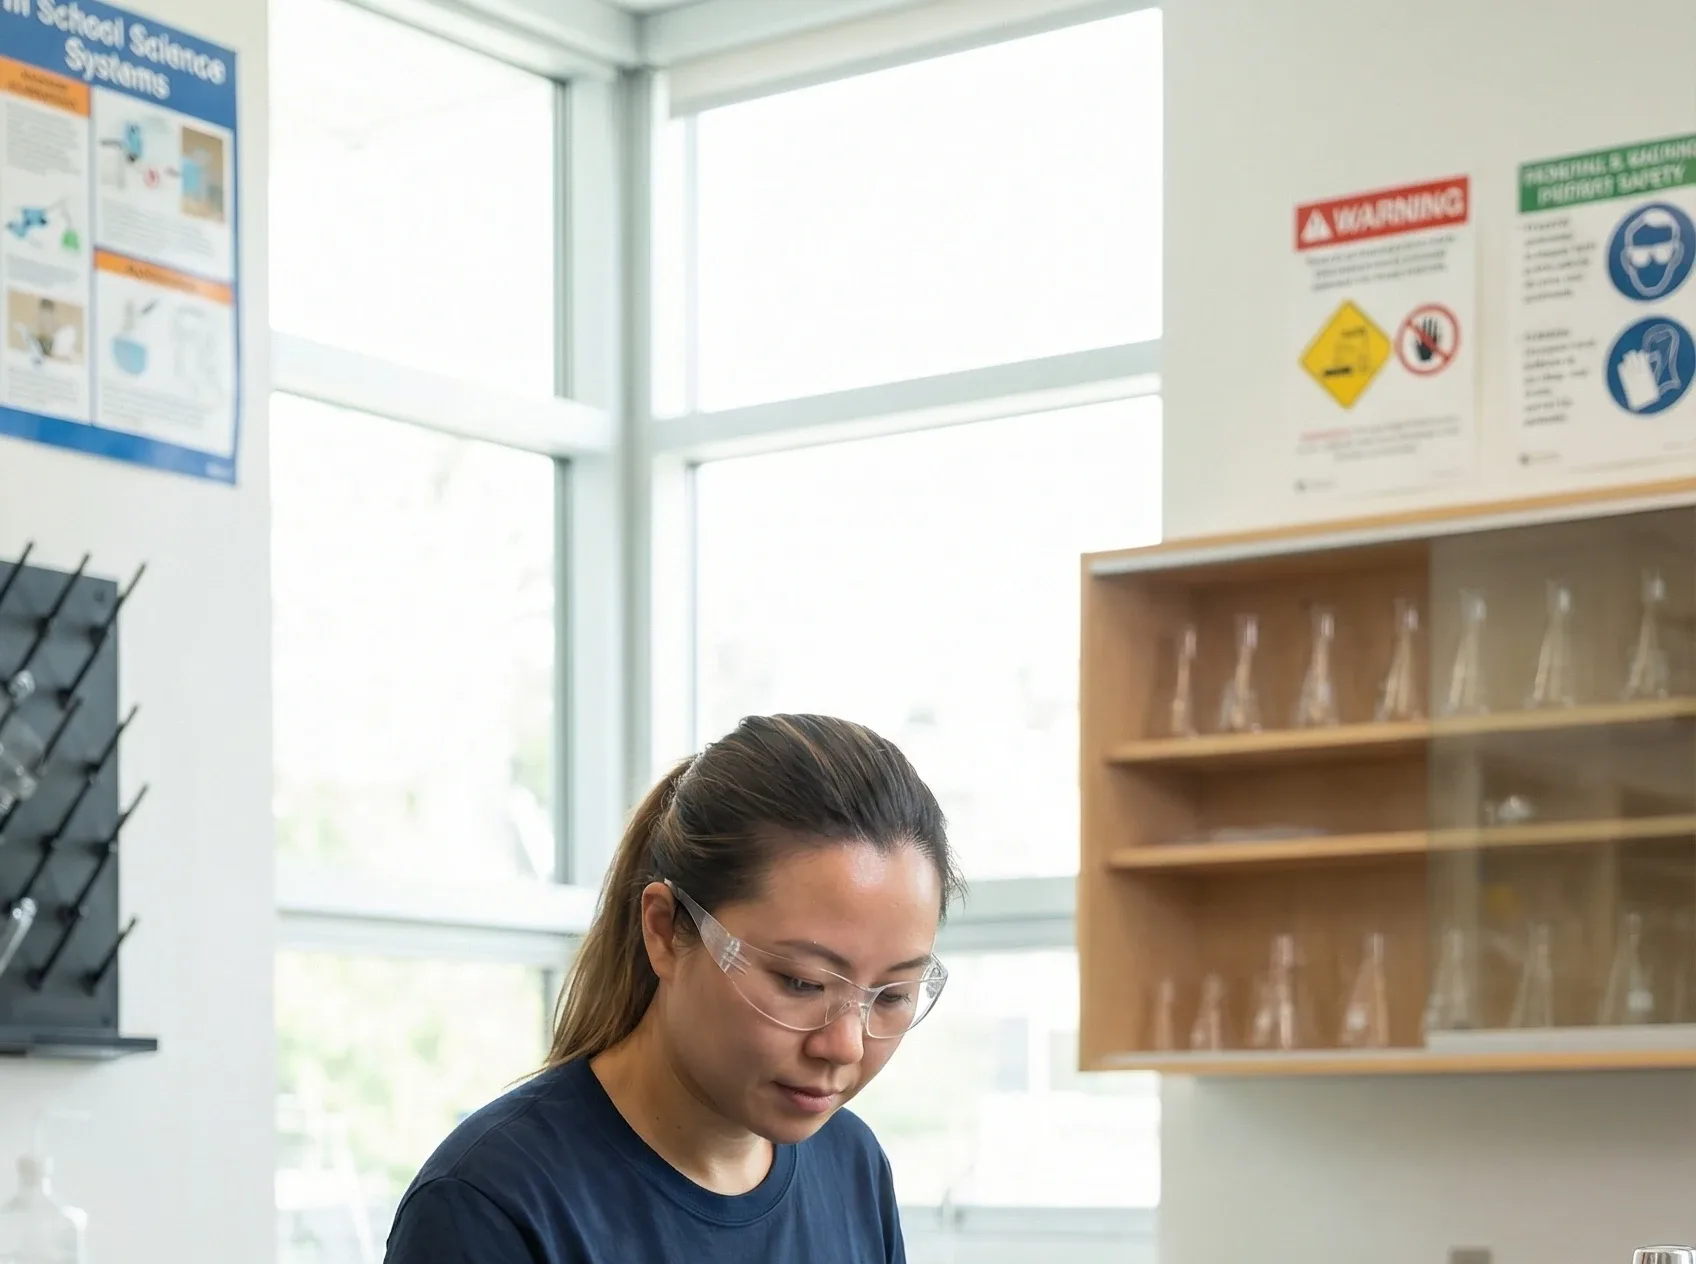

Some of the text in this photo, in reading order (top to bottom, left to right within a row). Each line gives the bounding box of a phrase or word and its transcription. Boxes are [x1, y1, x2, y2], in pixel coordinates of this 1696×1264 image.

[37, 0, 124, 50] School
[129, 23, 226, 84] Science
[65, 37, 170, 99] Systems
[1332, 187, 1464, 236] WARNING
